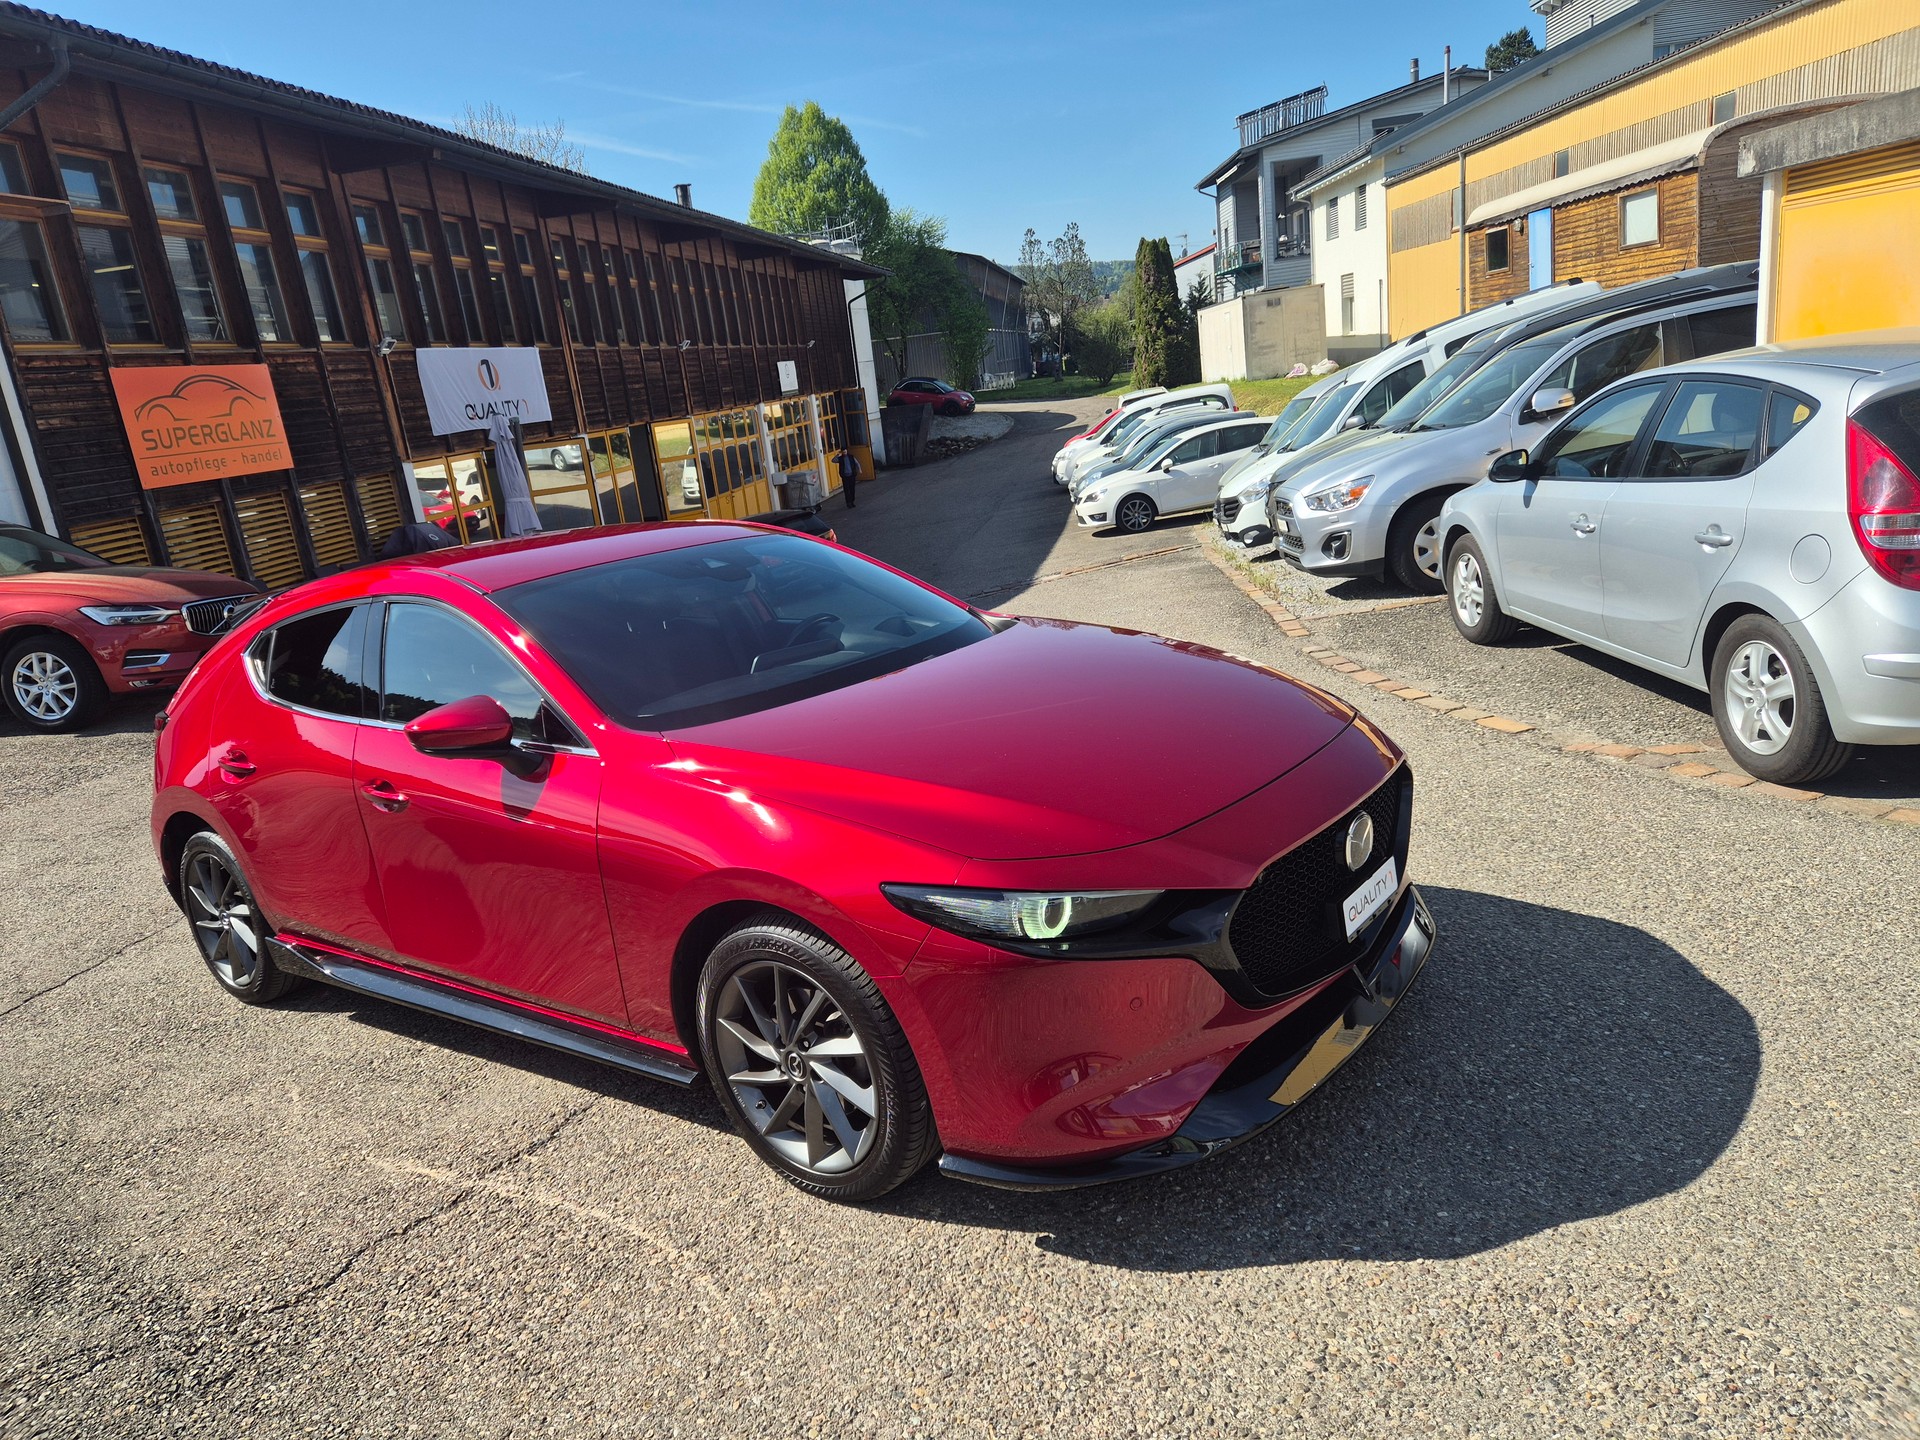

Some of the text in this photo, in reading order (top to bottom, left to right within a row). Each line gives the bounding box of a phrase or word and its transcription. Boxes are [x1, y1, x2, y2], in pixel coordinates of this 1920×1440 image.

[141, 419, 276, 451] SUPERGLANZ
[151, 457, 227, 477] autopflege
[241, 448, 283, 465] handel
